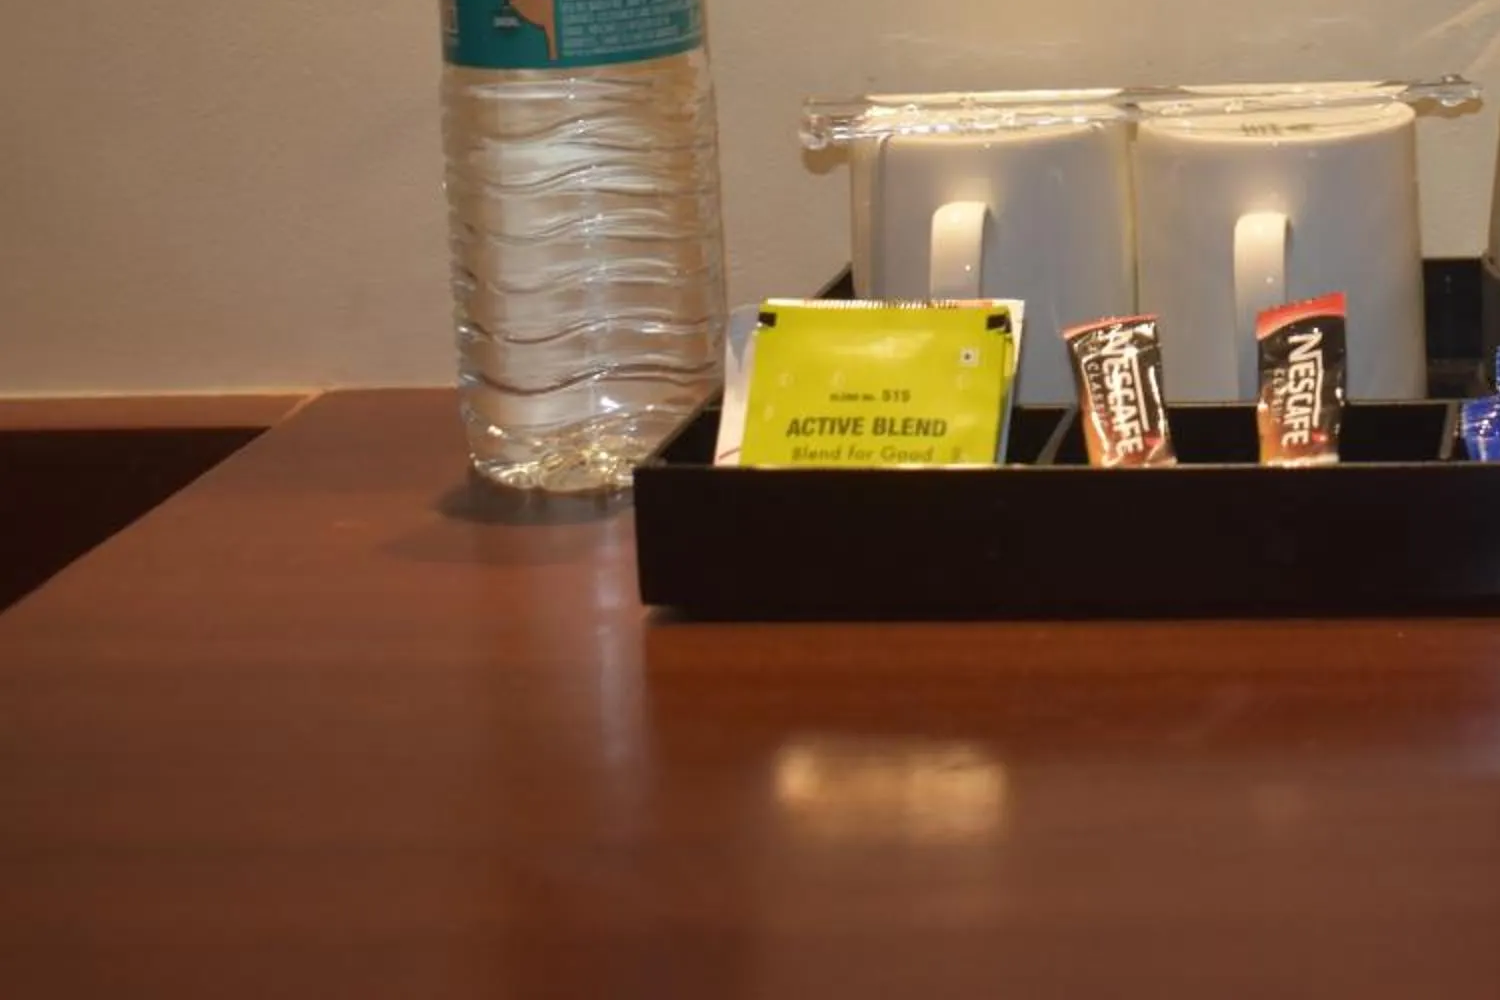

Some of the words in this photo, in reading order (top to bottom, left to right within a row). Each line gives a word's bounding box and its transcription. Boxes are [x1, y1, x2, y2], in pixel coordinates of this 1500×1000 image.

[786, 416, 865, 437] ACTIVE
[871, 416, 948, 438] BLEND
[791, 445, 842, 462] Blend
[847, 444, 873, 461] for
[880, 446, 934, 463] Good
